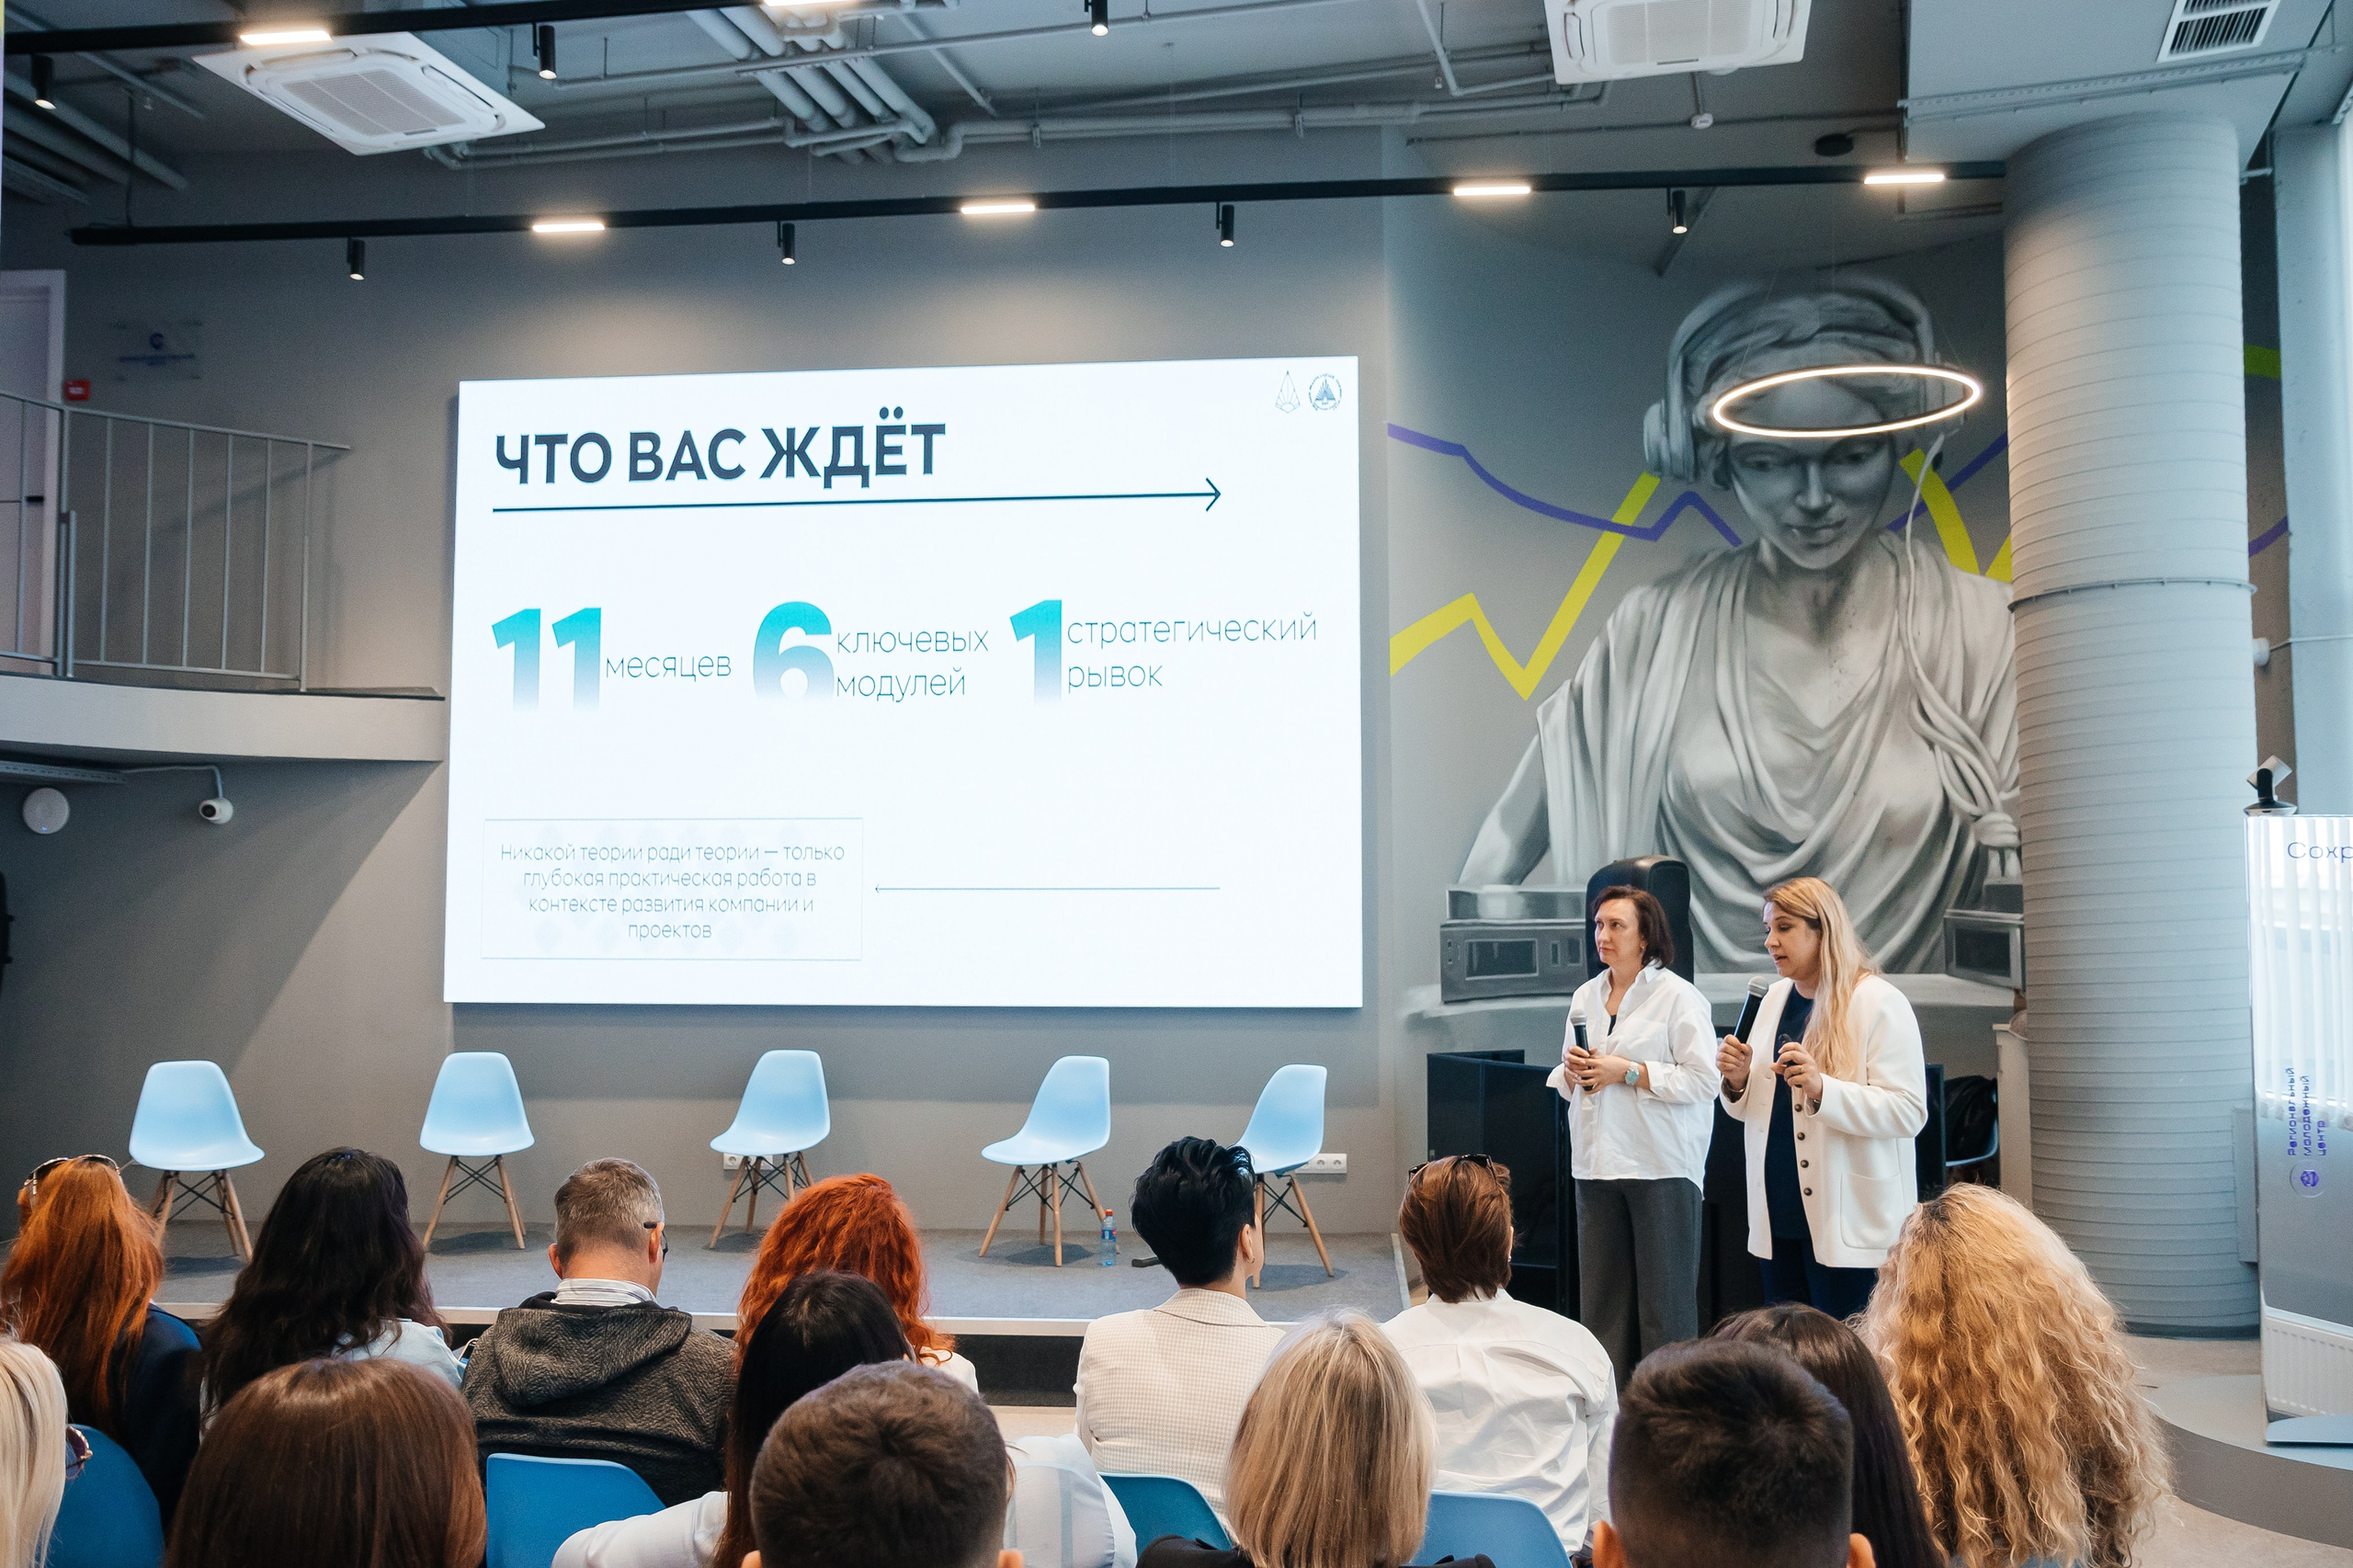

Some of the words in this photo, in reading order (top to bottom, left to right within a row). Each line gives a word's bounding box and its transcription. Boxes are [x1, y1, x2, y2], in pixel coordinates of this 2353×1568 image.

[495, 431, 613, 485] ЧТО
[628, 426, 746, 483] ВАС
[759, 405, 946, 490] ЖДЁТ
[491, 606, 602, 709] 11
[607, 655, 731, 683] месяцев
[753, 600, 835, 699] 6
[837, 630, 989, 653] ключевых
[1009, 598, 1063, 701] 1
[1067, 611, 1316, 650] стратегический
[837, 666, 964, 703] модулей
[1068, 665, 1163, 694] рывок
[502, 843, 574, 860] Никакой
[580, 846, 642, 864] теории
[648, 846, 690, 864] ради
[695, 846, 758, 863] теории
[783, 846, 845, 860] только
[524, 868, 603, 890] глубокая
[609, 872, 732, 890] практическая
[737, 868, 801, 890] работа
[807, 872, 816, 886] в
[529, 898, 617, 912] контексте
[622, 898, 703, 915] развития
[710, 898, 798, 913] компании
[803, 899, 813, 912] и
[629, 925, 711, 941] проектов
[2285, 1067, 2298, 1155] Региональный
[2317, 1119, 2327, 1155] центр
